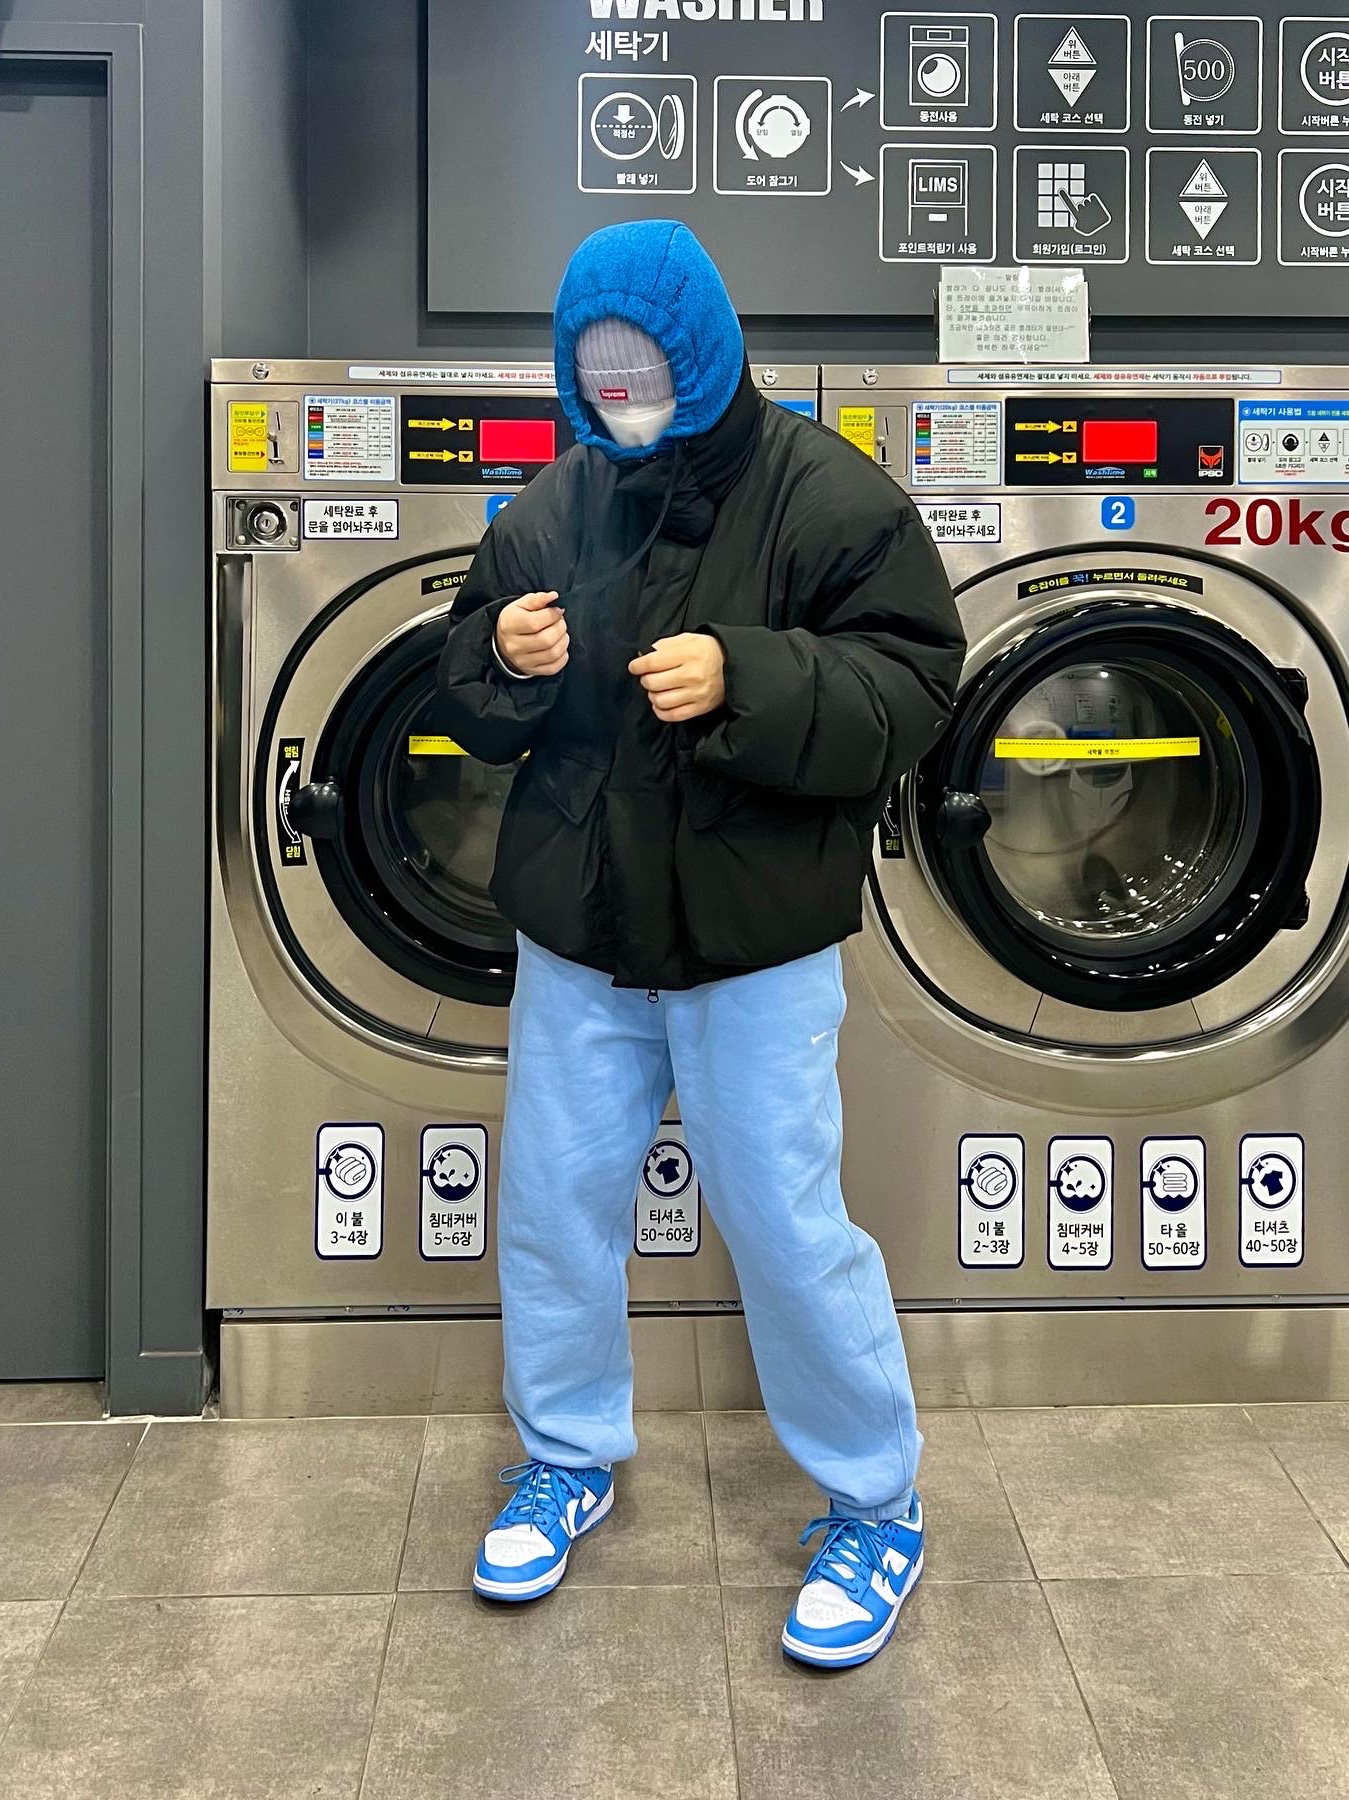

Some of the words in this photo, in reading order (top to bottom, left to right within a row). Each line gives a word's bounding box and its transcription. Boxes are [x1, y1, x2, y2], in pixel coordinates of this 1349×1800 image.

[585, 30, 669, 61] 세탁기
[1067, 39, 1078, 49] 위
[1063, 49, 1081, 60] 버튼
[1183, 59, 1225, 81] 500
[1062, 71, 1081, 82] 아래
[1062, 82, 1080, 93] 버튼
[919, 111, 958, 122] 동전사용
[1039, 113, 1059, 124] 세탁
[1062, 113, 1082, 125] 코스
[1084, 113, 1104, 125] 선택
[1183, 114, 1203, 126] 동전
[1204, 115, 1224, 127] 넣기
[1301, 115, 1340, 127] 시작버튼
[613, 129, 636, 139] 적정선
[616, 173, 636, 185] 빨래
[638, 173, 658, 185] 넣기
[747, 175, 766, 187] 도어
[768, 175, 798, 187] 잠그기
[1198, 172, 1208, 182] 위
[918, 176, 958, 192] LIMS
[1194, 181, 1212, 192] 버튼
[1194, 204, 1212, 215] 아래
[1194, 214, 1212, 225] 버튼
[898, 243, 955, 254] 포인트적립기
[957, 243, 977, 254] 사용
[1032, 243, 1106, 255] 회원가입(로그인)
[1171, 245, 1191, 257] 세탁
[1193, 246, 1214, 257] 코스
[1215, 246, 1235, 257] 선택
[1300, 246, 1338, 258] 시작버튼
[400, 370, 439, 378] 섬유유연제는
[440, 371, 459, 379] 절대로
[1113, 373, 1151, 381] 섬유유연제는
[1252, 407, 1275, 416] 세탁기
[1278, 407, 1302, 416] 사용법
[323, 504, 364, 517] 세탁완료
[368, 504, 379, 517] 후
[928, 509, 968, 521] 세탁완료
[971, 509, 981, 521] 후
[1110, 501, 1126, 524] 2
[308, 520, 328, 533] 문을
[332, 520, 394, 534] 열어놔주세요
[936, 525, 996, 537] 열어놔주세요
[432, 574, 468, 589] 손잡이
[1028, 576, 1070, 593] 손잡이를
[1092, 571, 1134, 582] 누르면서
[284, 746, 299, 758] 열림
[285, 846, 300, 858] 닫힘
[335, 1211, 348, 1228] 이
[350, 1211, 364, 1227] 불
[429, 1212, 478, 1229] 침대커버
[649, 1209, 685, 1224] 티셔츠
[978, 1222, 990, 1237] 이
[993, 1222, 1006, 1236] 불
[1057, 1223, 1104, 1239] 침대커버
[1160, 1223, 1173, 1238] 타
[1174, 1223, 1188, 1238] 올
[1254, 1220, 1290, 1236] 티셔츠
[330, 1230, 368, 1245] 3~4장
[434, 1231, 472, 1247] 5~6장
[640, 1227, 694, 1243] 50~60장
[972, 1239, 1010, 1255] 2~3장
[1061, 1241, 1099, 1256] 4~5장
[1148, 1241, 1200, 1256] 50~60장
[1245, 1238, 1298, 1254] 40~50장
